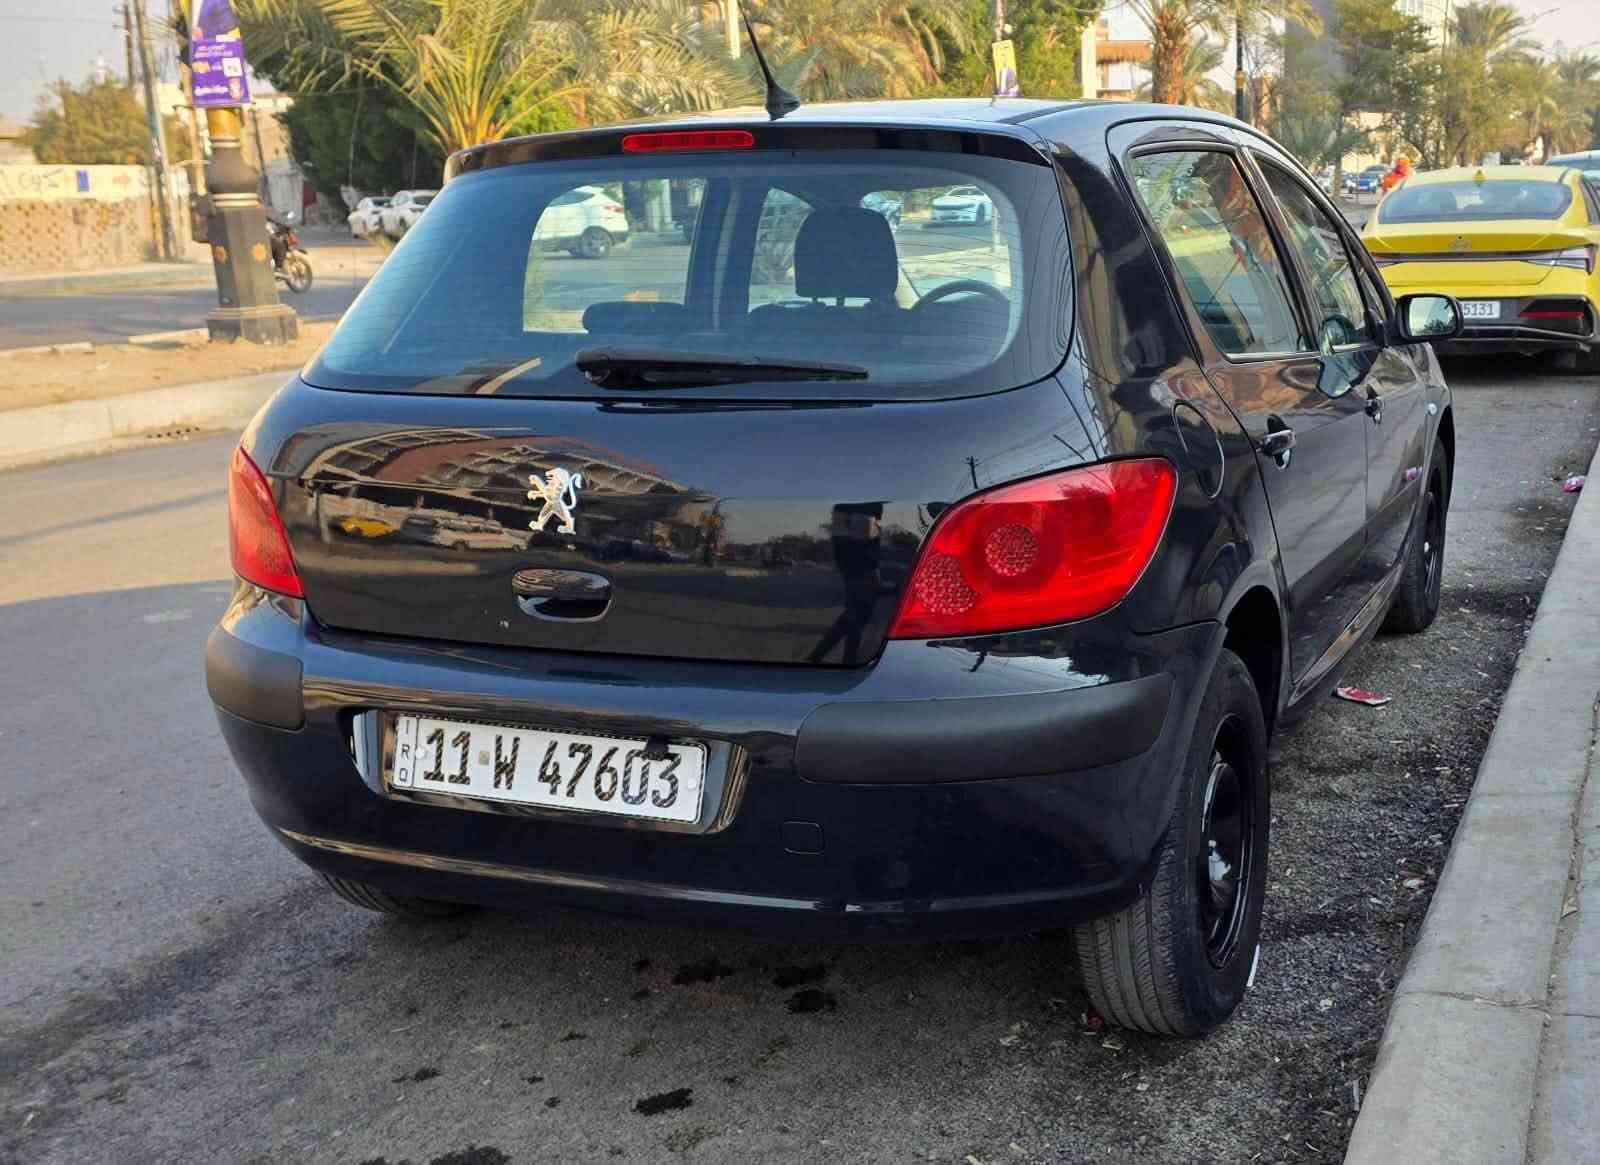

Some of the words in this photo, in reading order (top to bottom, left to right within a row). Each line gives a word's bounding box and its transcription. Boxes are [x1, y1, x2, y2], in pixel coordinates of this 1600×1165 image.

[424, 728, 471, 785] 11
[493, 734, 520, 790] W
[538, 740, 682, 809] 47603
